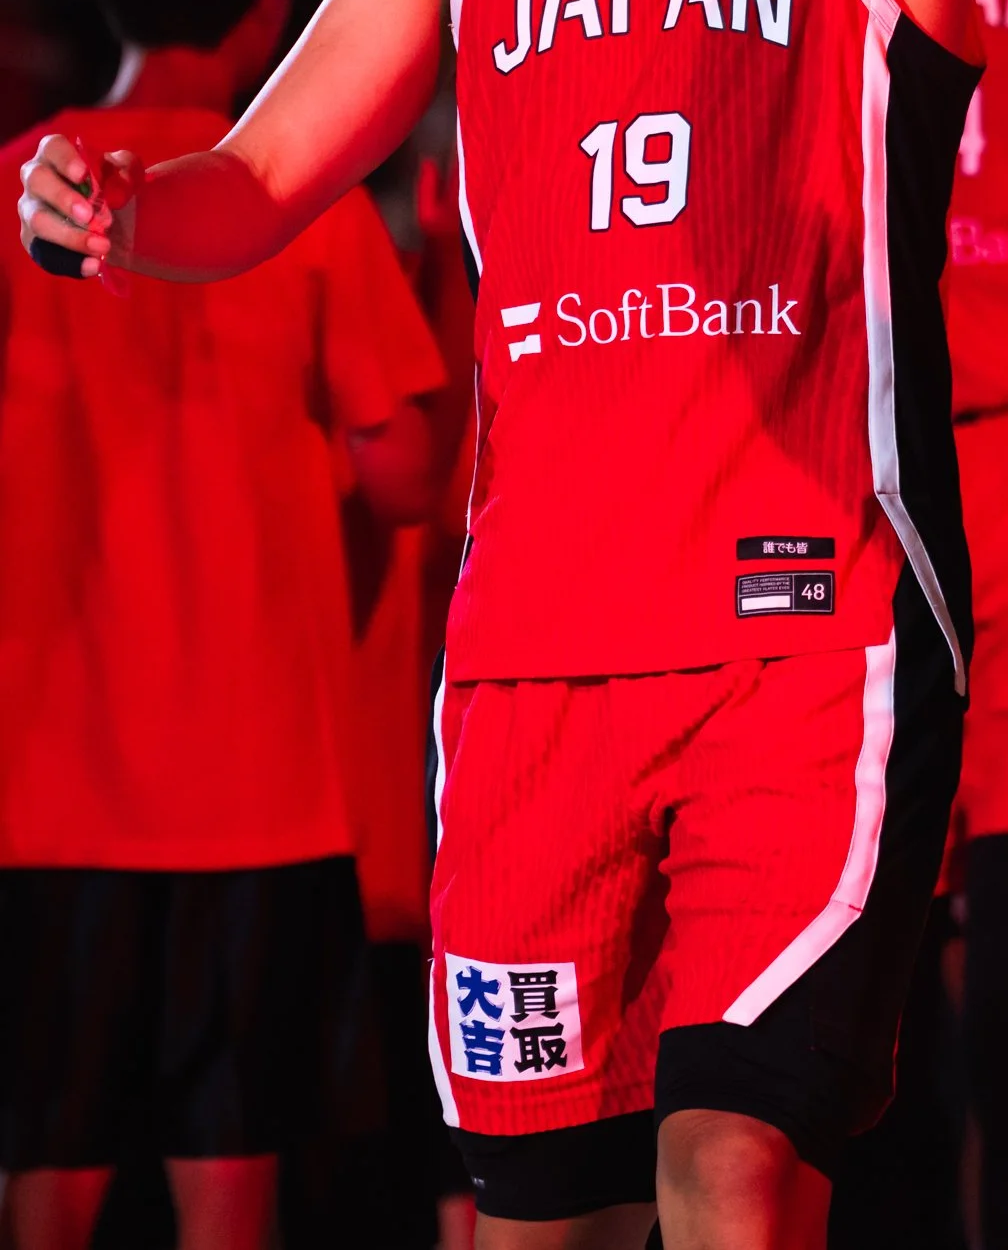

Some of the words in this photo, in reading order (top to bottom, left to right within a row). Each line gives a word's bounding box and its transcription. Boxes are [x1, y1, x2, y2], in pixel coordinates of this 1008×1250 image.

[579, 111, 692, 232] 19
[556, 283, 801, 347] SoftBank
[762, 541, 808, 554] 誰でも皆
[801, 583, 825, 601] 48
[456, 965, 505, 1076] 大吉
[507, 969, 567, 1073] 買取
